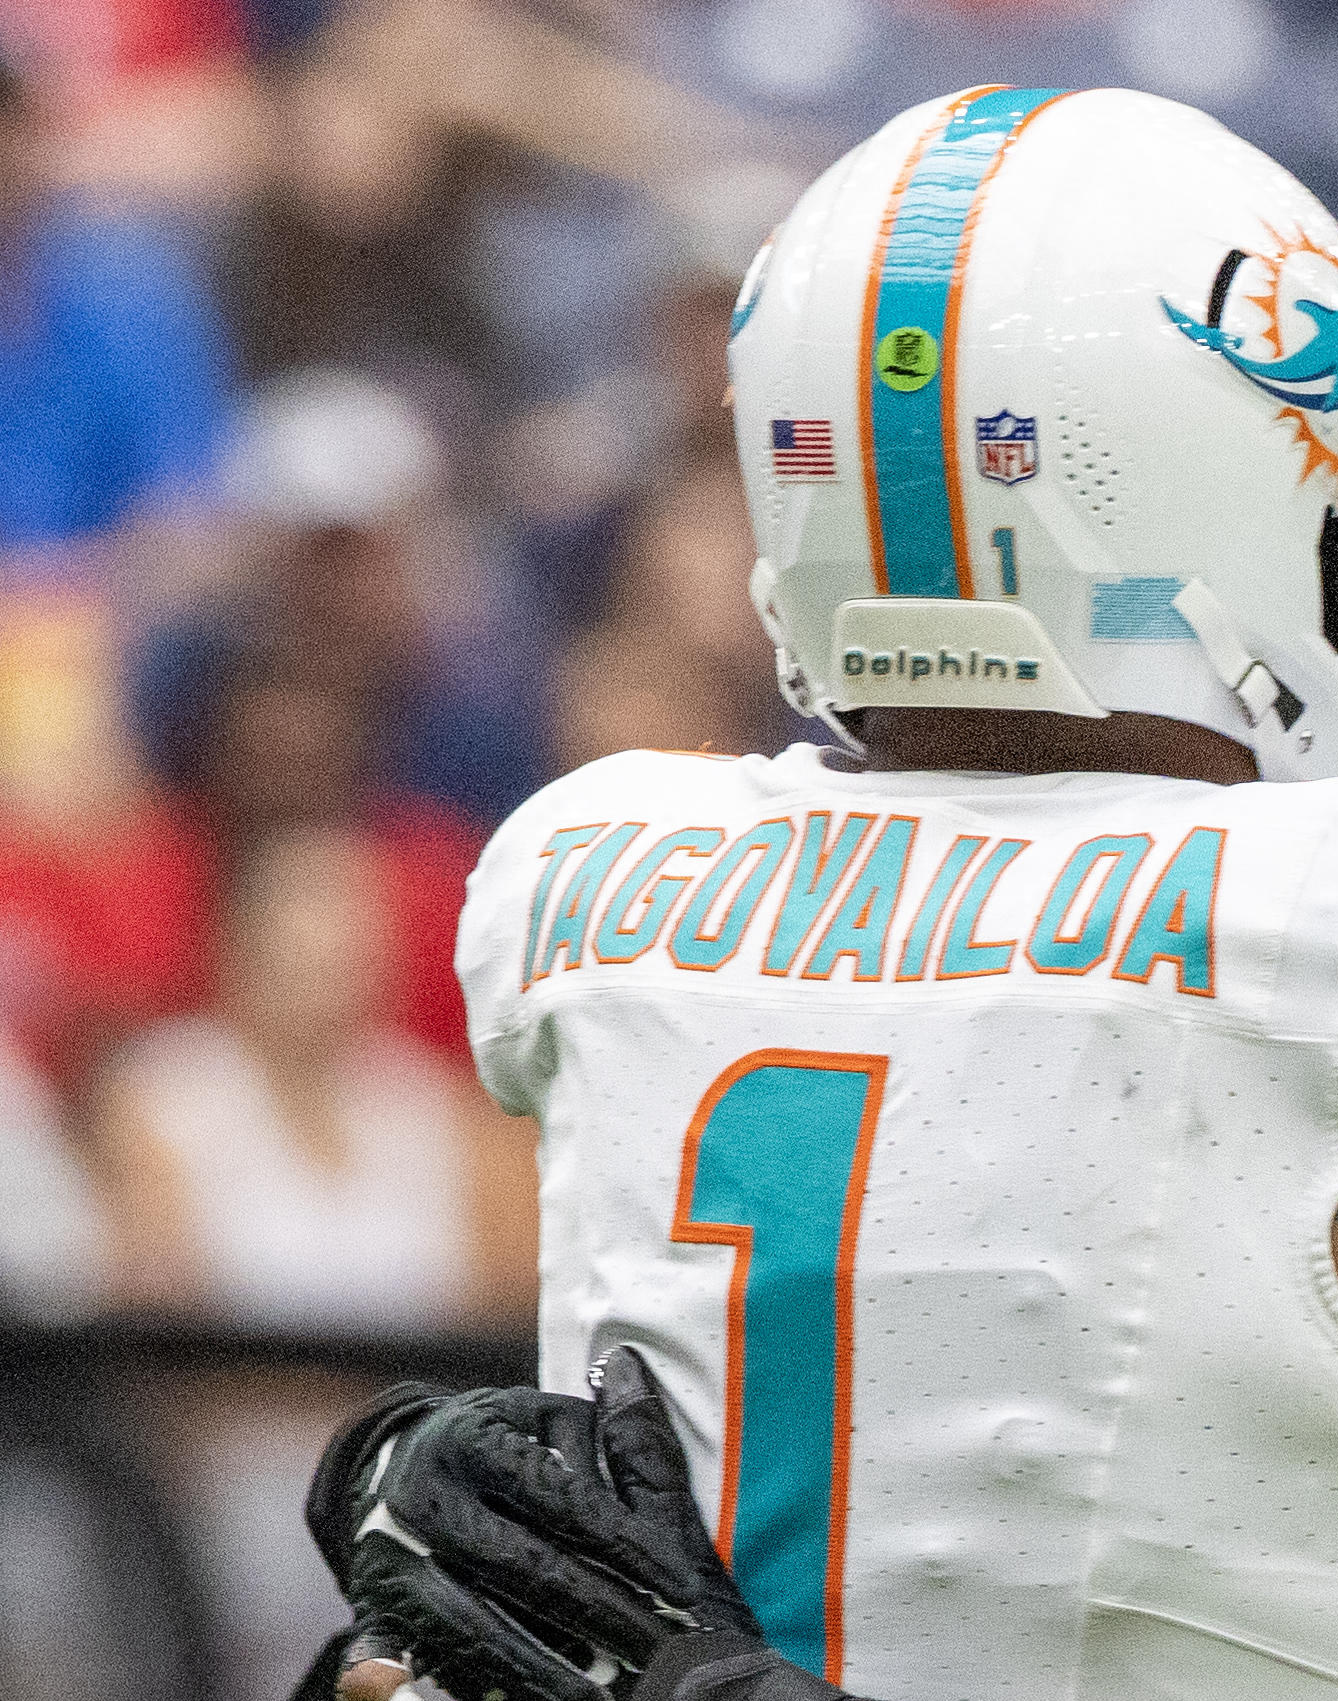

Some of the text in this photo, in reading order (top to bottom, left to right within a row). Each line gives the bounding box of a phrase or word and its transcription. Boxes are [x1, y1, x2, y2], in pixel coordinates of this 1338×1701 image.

[983, 443, 1036, 478] NFL
[990, 526, 1019, 597] 1
[843, 648, 1040, 682] Dolphins
[522, 810, 1230, 998] TAGOVAILOA
[671, 1047, 890, 1686] 1
